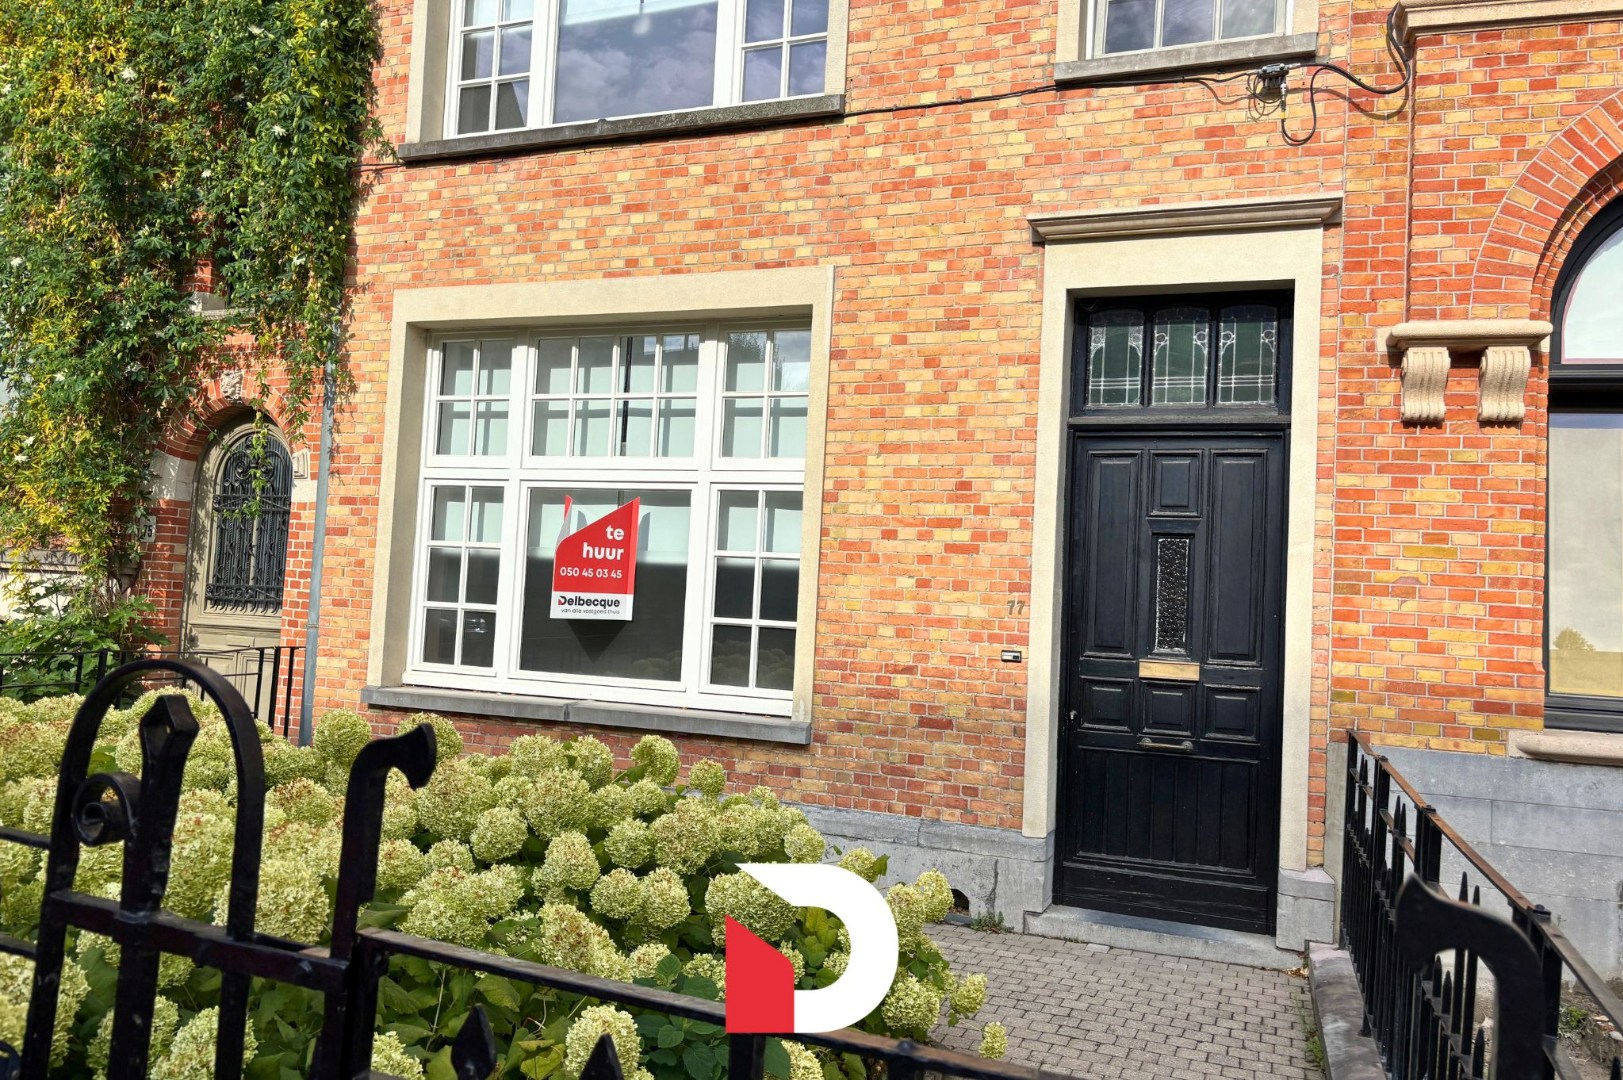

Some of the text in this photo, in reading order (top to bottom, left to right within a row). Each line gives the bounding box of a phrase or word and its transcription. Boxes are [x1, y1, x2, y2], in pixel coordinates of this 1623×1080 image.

[143, 524, 153, 538] 75
[606, 525, 624, 540] te
[582, 542, 624, 560] huur
[560, 567, 622, 579] 050 45 03 45
[558, 596, 620, 609] Delbecque
[1007, 600, 1025, 615] 77
